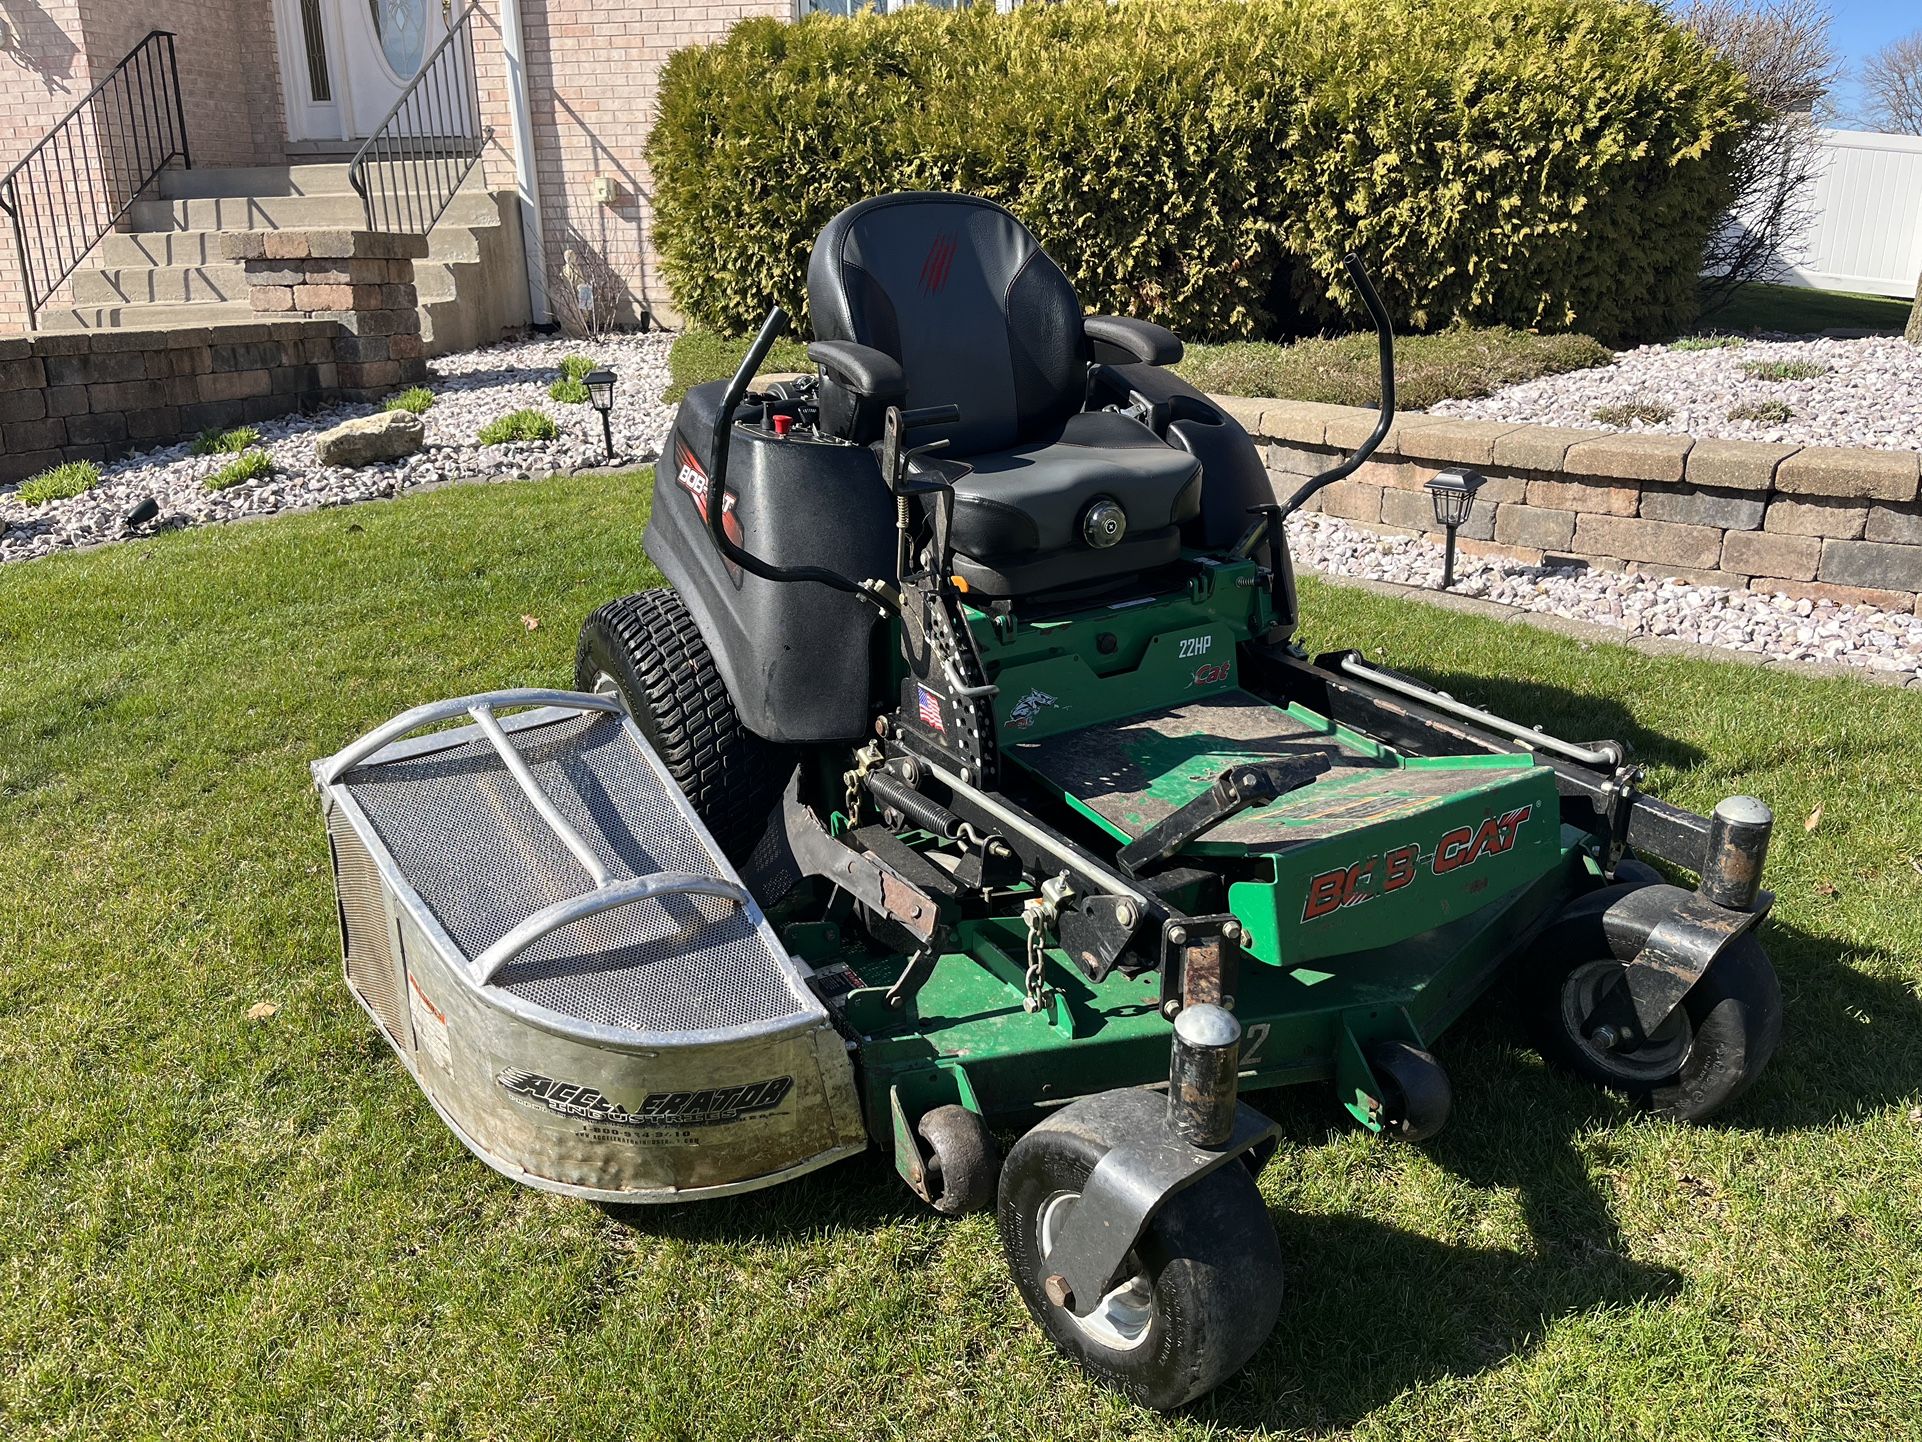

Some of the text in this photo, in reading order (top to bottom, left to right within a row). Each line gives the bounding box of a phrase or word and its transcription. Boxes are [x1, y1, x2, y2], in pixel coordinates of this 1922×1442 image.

[677, 464, 737, 513] BOB-T
[1178, 635, 1212, 659] 22HP
[1239, 1023, 1271, 1066] 2
[496, 1066, 792, 1116] ACCEERATOR
[548, 1100, 738, 1124] INDUSTRIES
